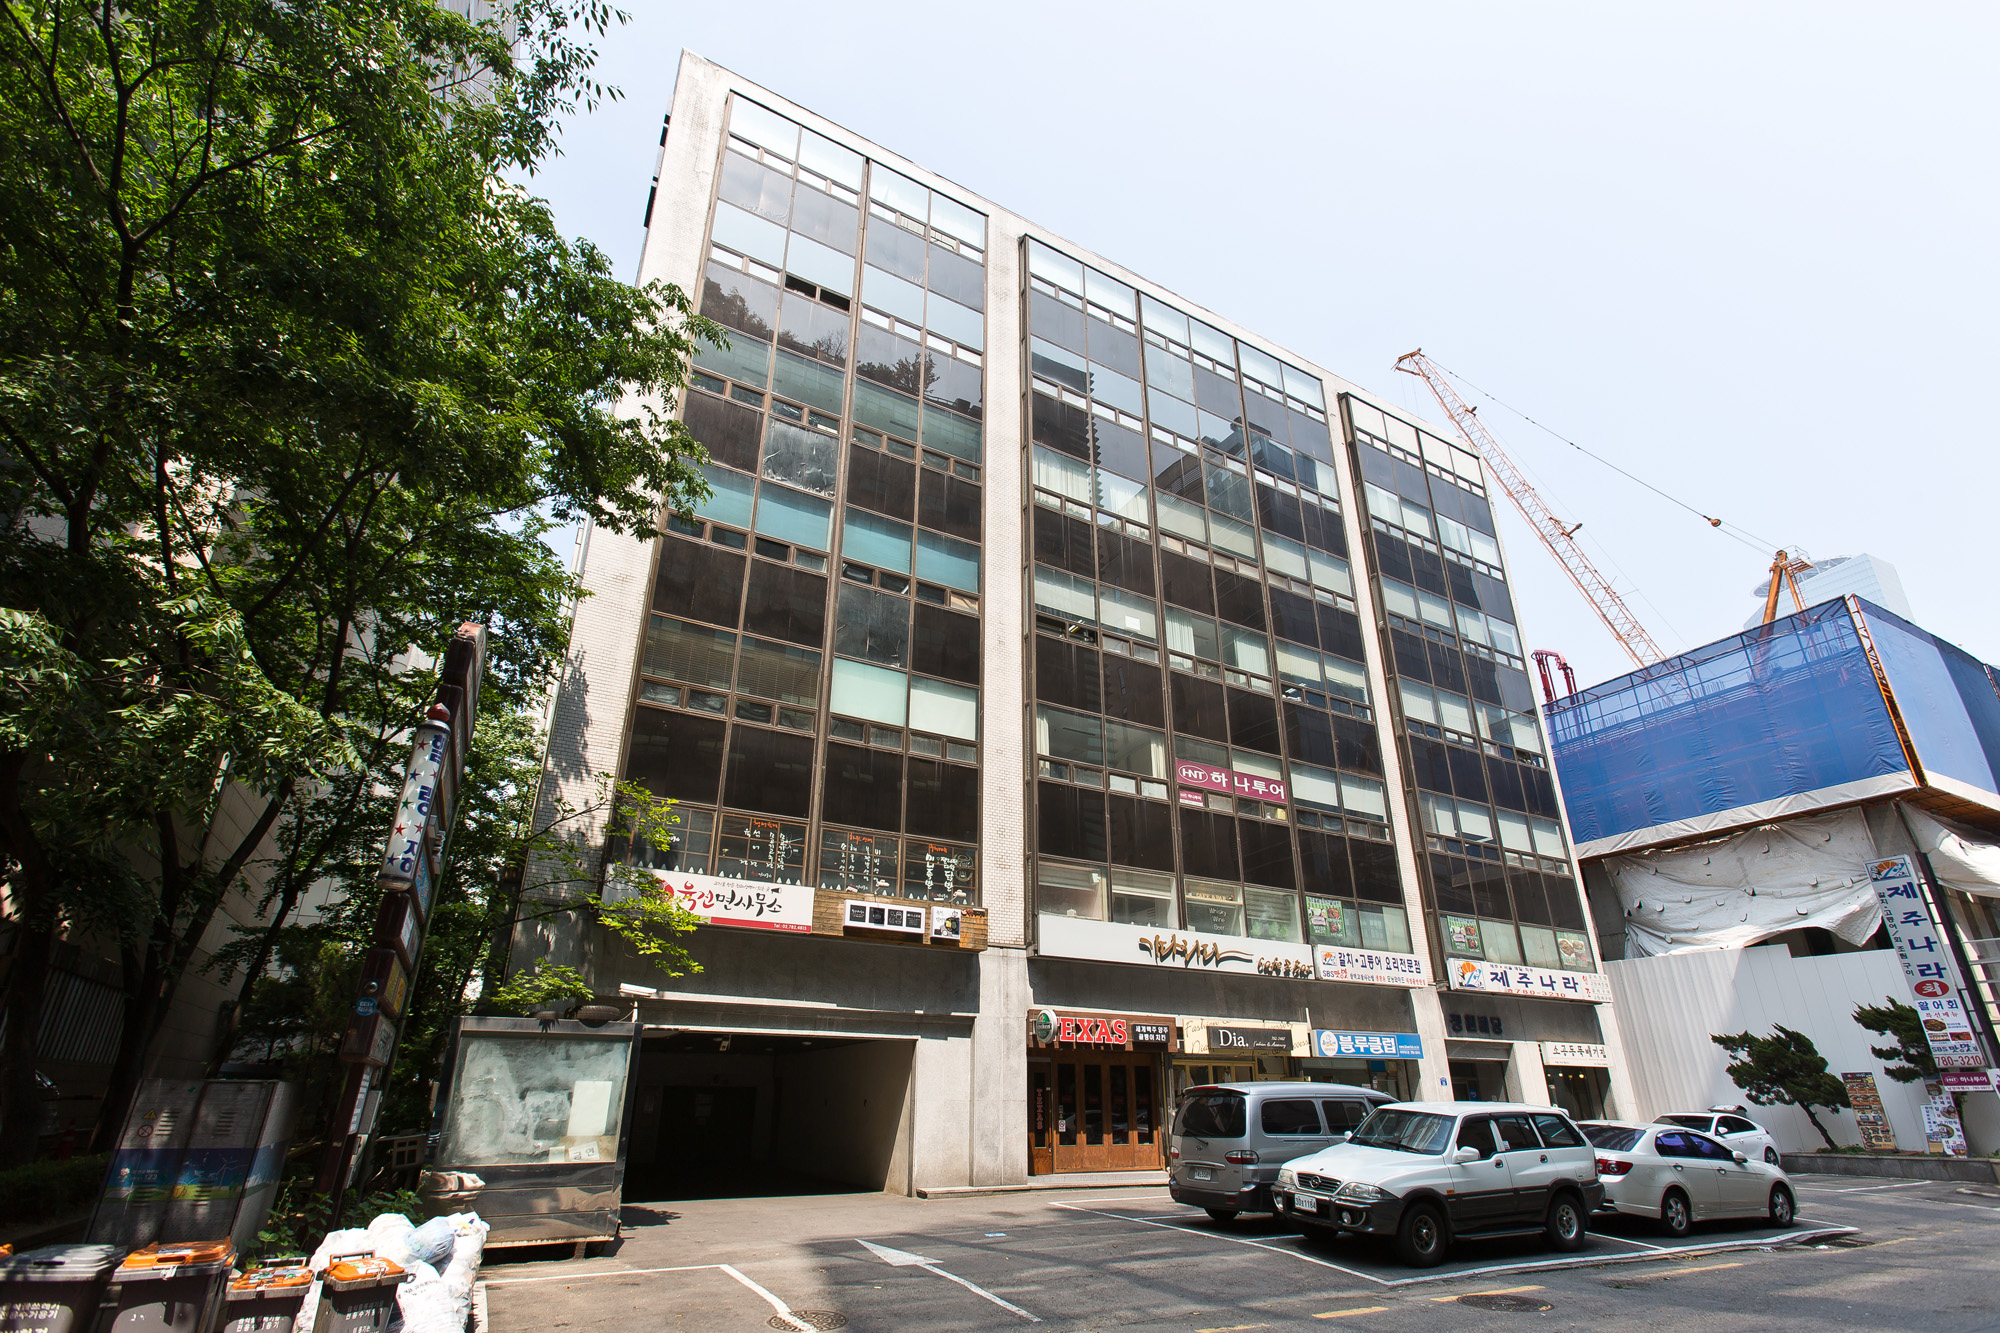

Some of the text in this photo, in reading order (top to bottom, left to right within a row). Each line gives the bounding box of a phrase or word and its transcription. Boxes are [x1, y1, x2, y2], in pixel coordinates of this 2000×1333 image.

[1182, 768, 1205, 779] HNT
[1210, 771, 1285, 800] 하나투어
[1886, 881, 1947, 978] 제주나라
[1385, 956, 1422, 974] 요리전문점
[1902, 962, 1914, 976] 구이
[1322, 970, 1335, 978] SBS
[1489, 970, 1579, 993] 제주나라
[1514, 989, 1566, 998] 780-3210
[1917, 999, 1959, 1011] 활어회
[1158, 1026, 1169, 1034] 양주
[1218, 1029, 1249, 1048] Dia.
[1339, 1035, 1395, 1054] 블루클럽
[1934, 1055, 1982, 1066] 780-3210
